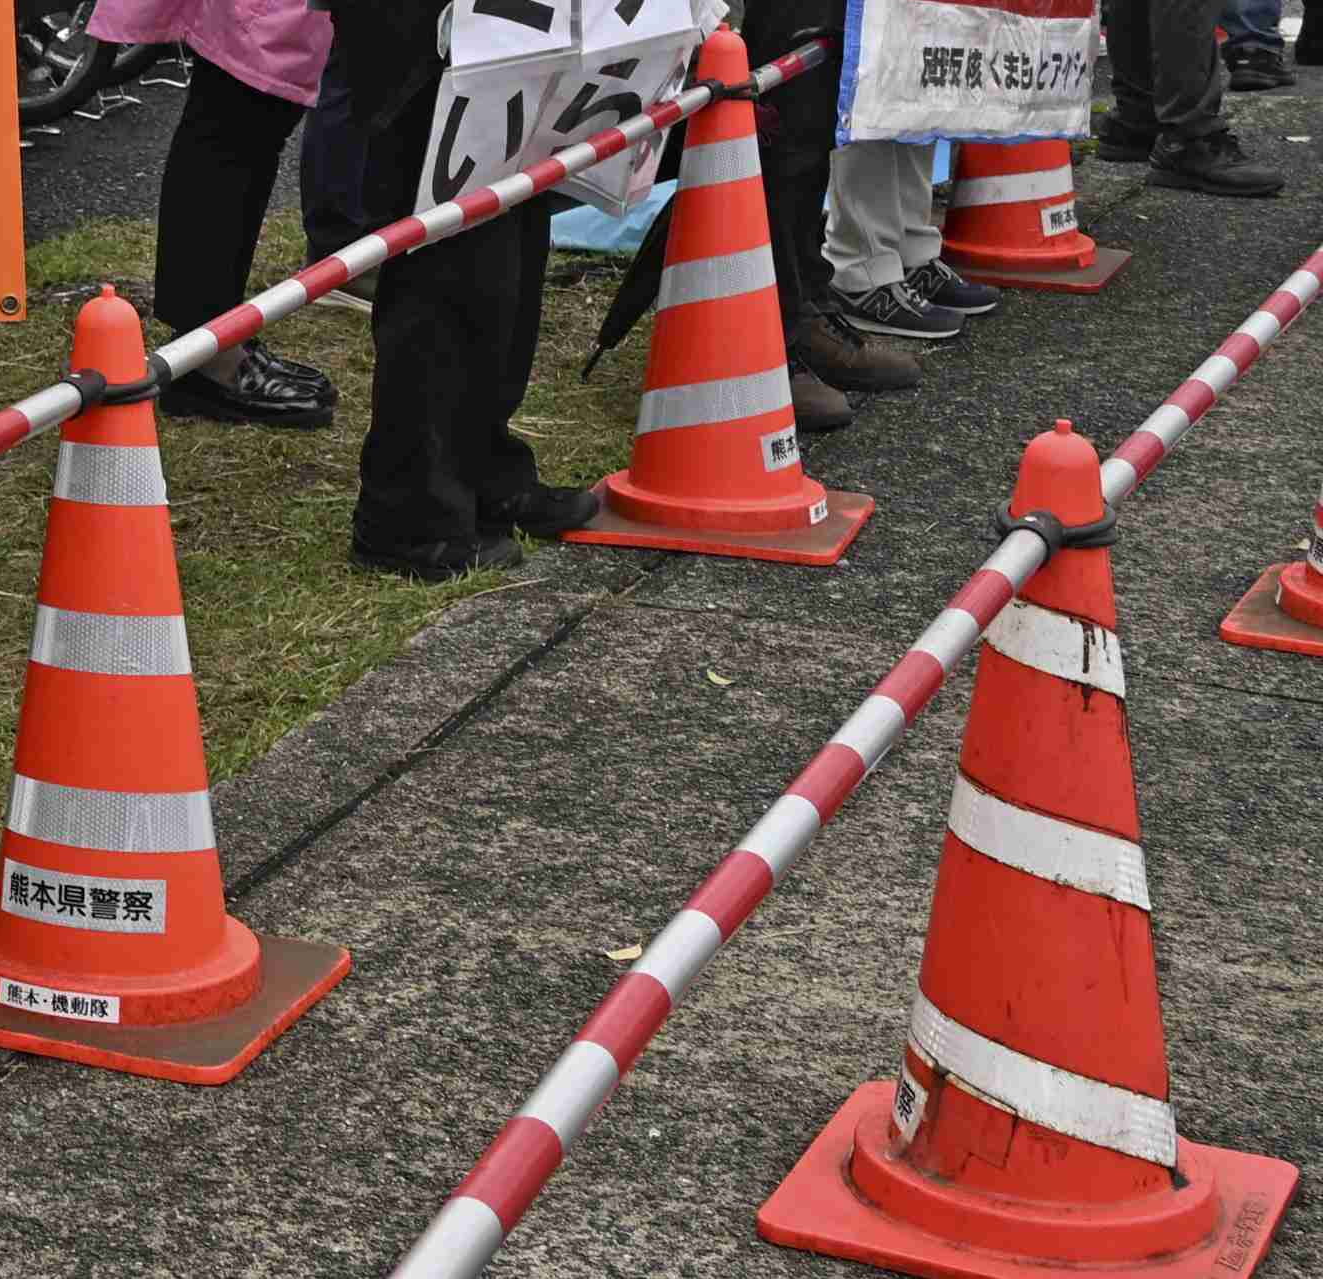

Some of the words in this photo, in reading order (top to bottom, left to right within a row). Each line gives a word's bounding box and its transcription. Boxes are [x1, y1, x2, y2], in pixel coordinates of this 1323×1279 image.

[8, 872, 154, 923] 熊本県警察
[6, 984, 110, 1019] 熊本・機動隊
